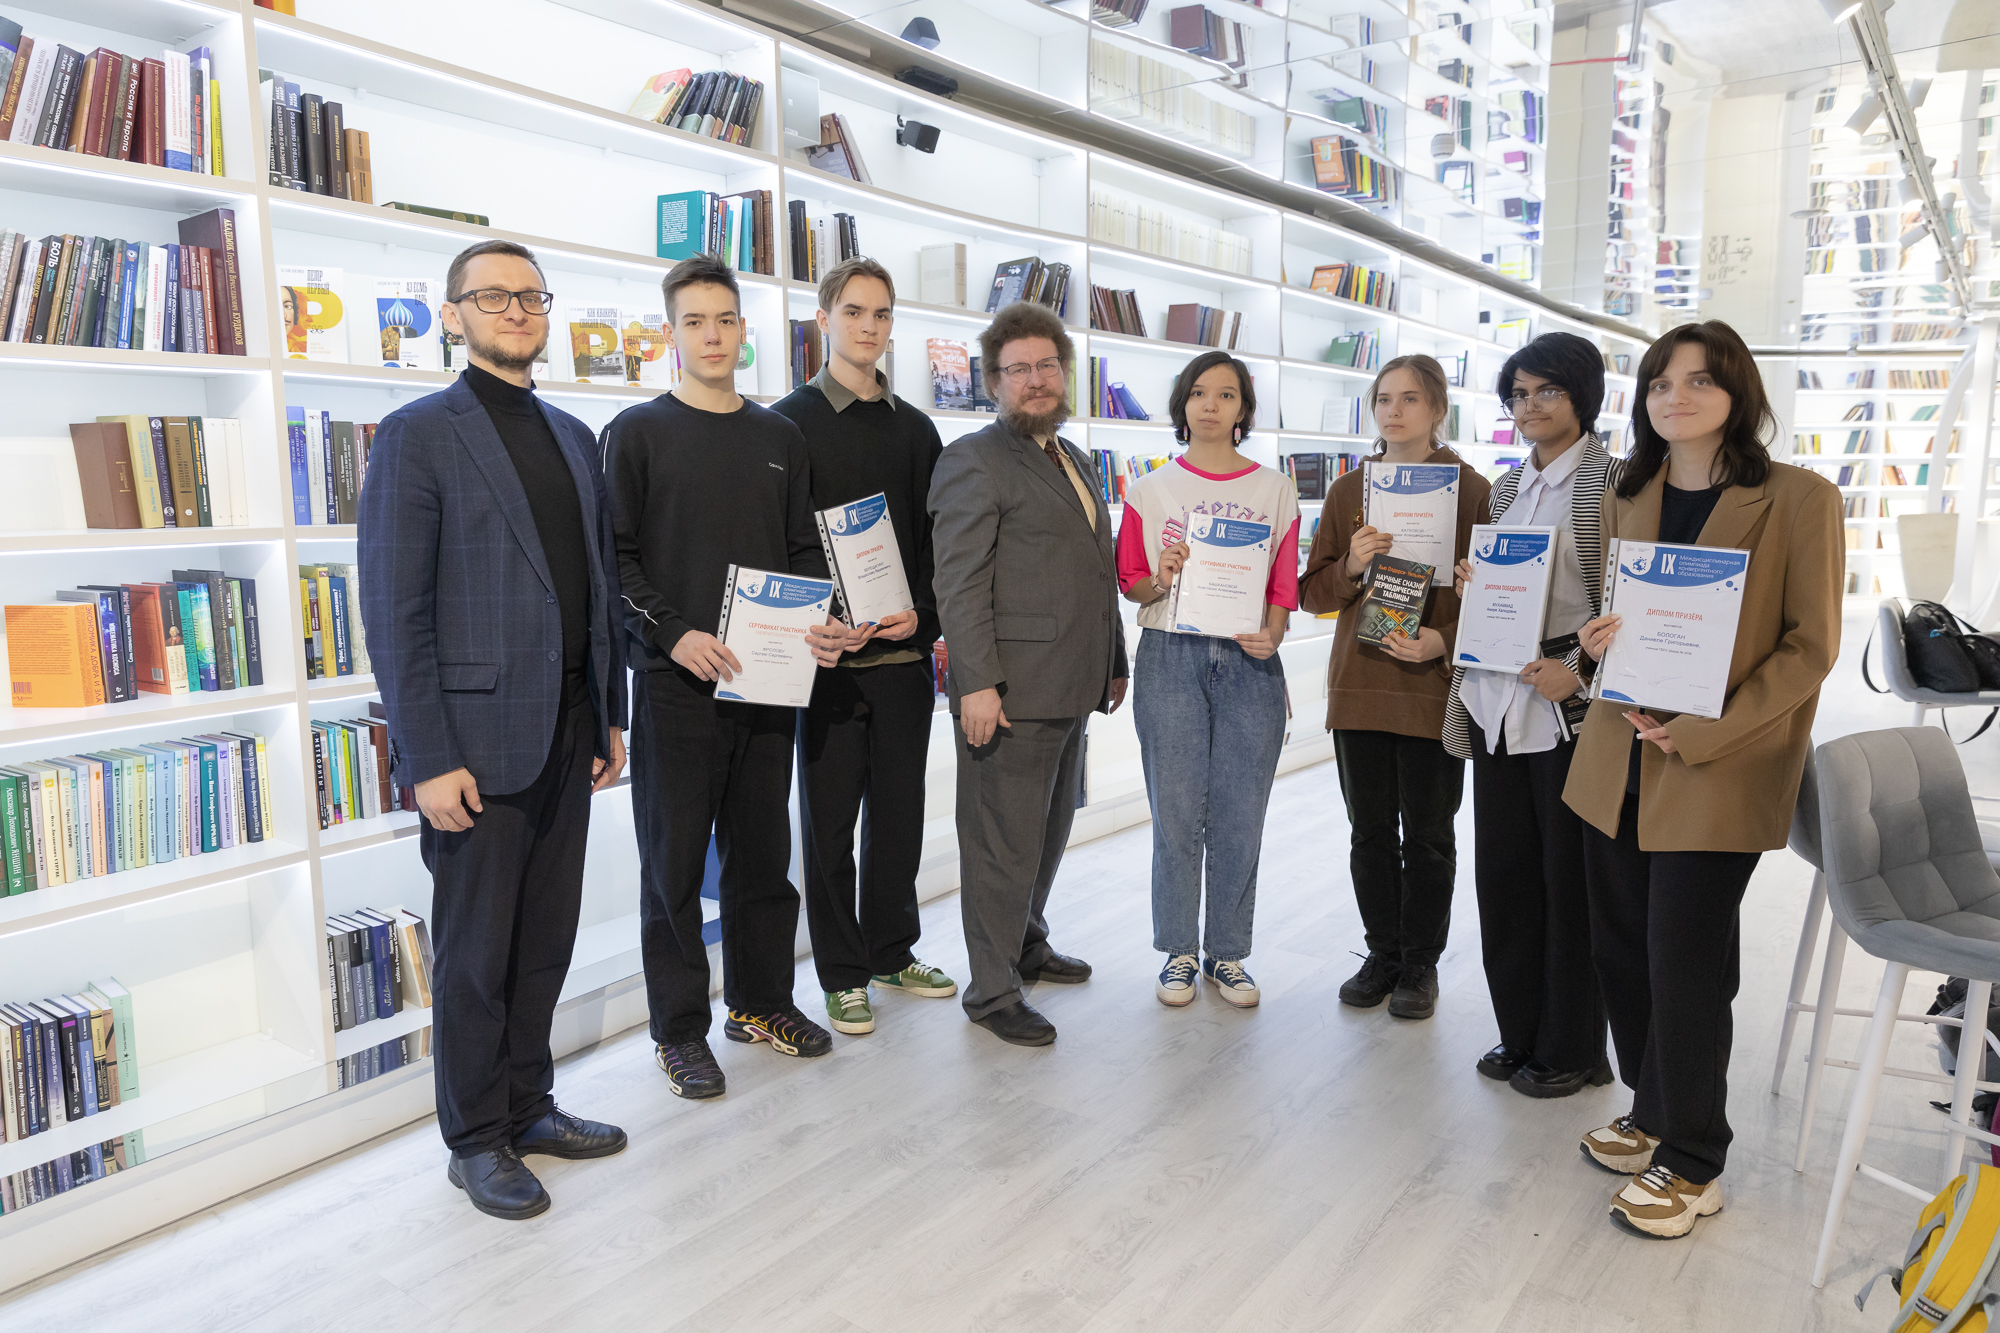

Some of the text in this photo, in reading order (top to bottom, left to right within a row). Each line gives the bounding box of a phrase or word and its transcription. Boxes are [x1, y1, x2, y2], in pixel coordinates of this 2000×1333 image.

[127, 79, 137, 110] Россия
[121, 120, 132, 151] Европа
[47, 241, 60, 267] БОЛЬ
[223, 218, 233, 250] АКАДЕМИК
[232, 311, 243, 344] КУРДЮМОВ
[156, 439, 170, 504] КВАНТОВЫЙ ЛАБИРИНТ
[1401, 470, 1411, 485] IX
[848, 508, 859, 525] IX
[1216, 523, 1226, 538] IX
[1498, 538, 1508, 555] IX
[1660, 553, 1676, 574] IX
[1679, 560, 1709, 568] олимпиада
[1680, 555, 1740, 565] Междисциплинарная
[1677, 570, 1713, 578] образования
[1678, 565, 1723, 574] конвергентного
[769, 580, 782, 598] IX
[1373, 580, 1422, 597] ПЕРИОДИЧЕСКОЙ
[1375, 573, 1424, 589] НАУЧНЫЕ СКАЗКИ
[1382, 590, 1409, 602] ТАБЛИЦЫ
[1646, 608, 1703, 620] ДИПЛОМ ПРИЗЁРА
[748, 622, 779, 630] СЕРТИФИКАТ
[85, 606, 96, 652] ЭКОНОМИКА
[91, 655, 99, 678] ДОБРА
[1656, 631, 1685, 639] БОЛОГАН
[314, 738, 323, 785] МЕТЕОРИТЫ
